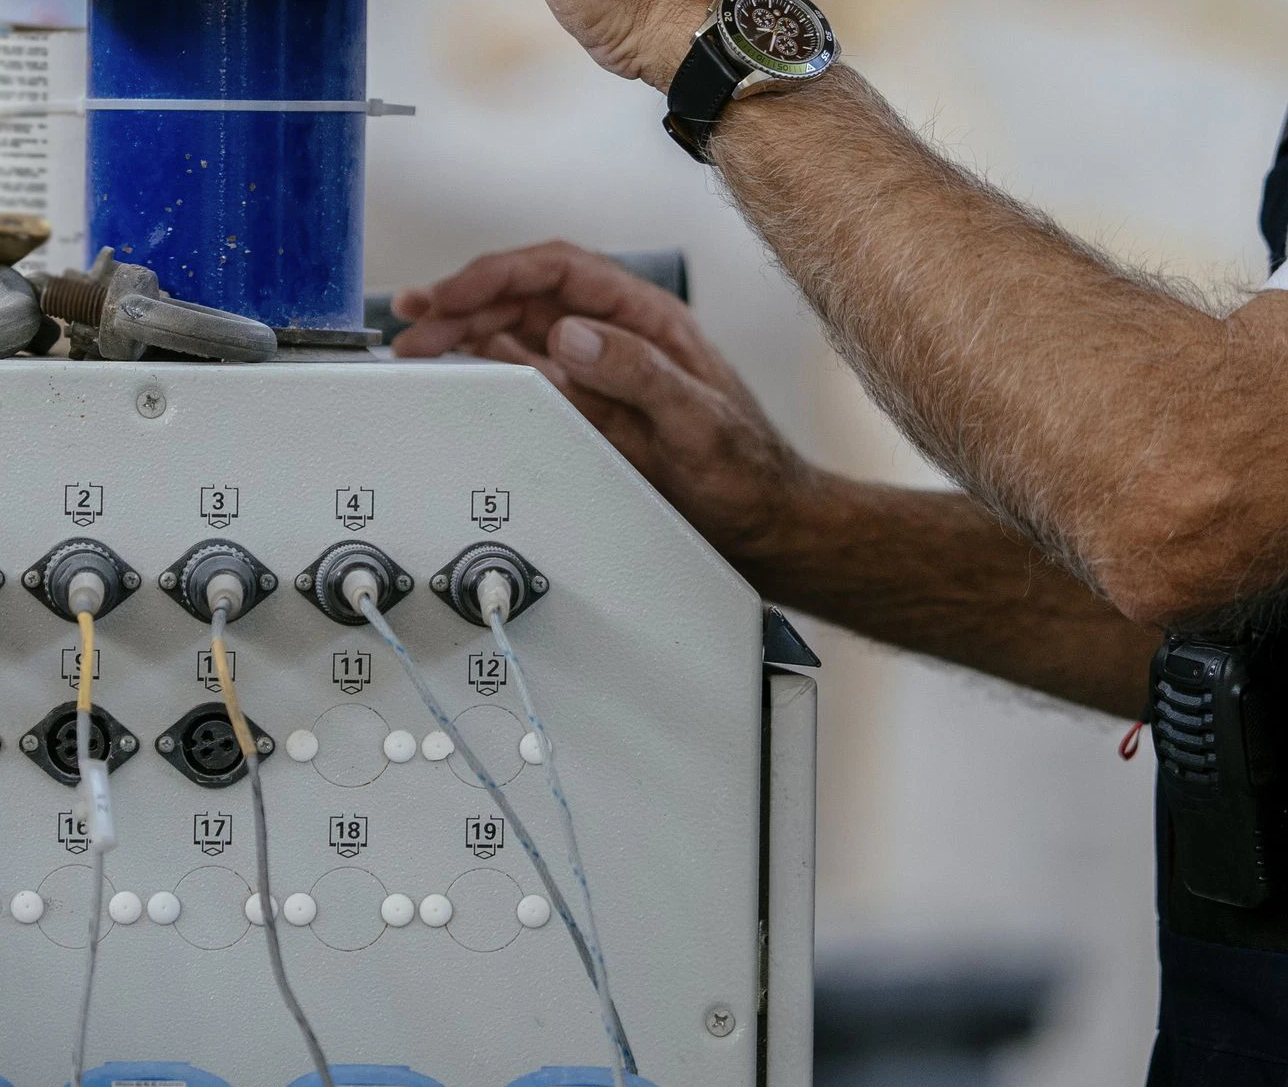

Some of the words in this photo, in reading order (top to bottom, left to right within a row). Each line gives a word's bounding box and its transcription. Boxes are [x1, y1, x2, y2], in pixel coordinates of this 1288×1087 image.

[723, 11, 733, 22] 20
[821, 49, 830, 62] 55
[77, 489, 90, 507] 2
[212, 492, 224, 511] 3
[347, 493, 360, 512] 4
[485, 495, 496, 514] 5
[340, 657, 363, 676] 11
[475, 659, 500, 677] 12
[64, 817, 89, 836] 16
[201, 819, 226, 838] 17
[335, 821, 361, 840] 18
[472, 822, 497, 841] 19
